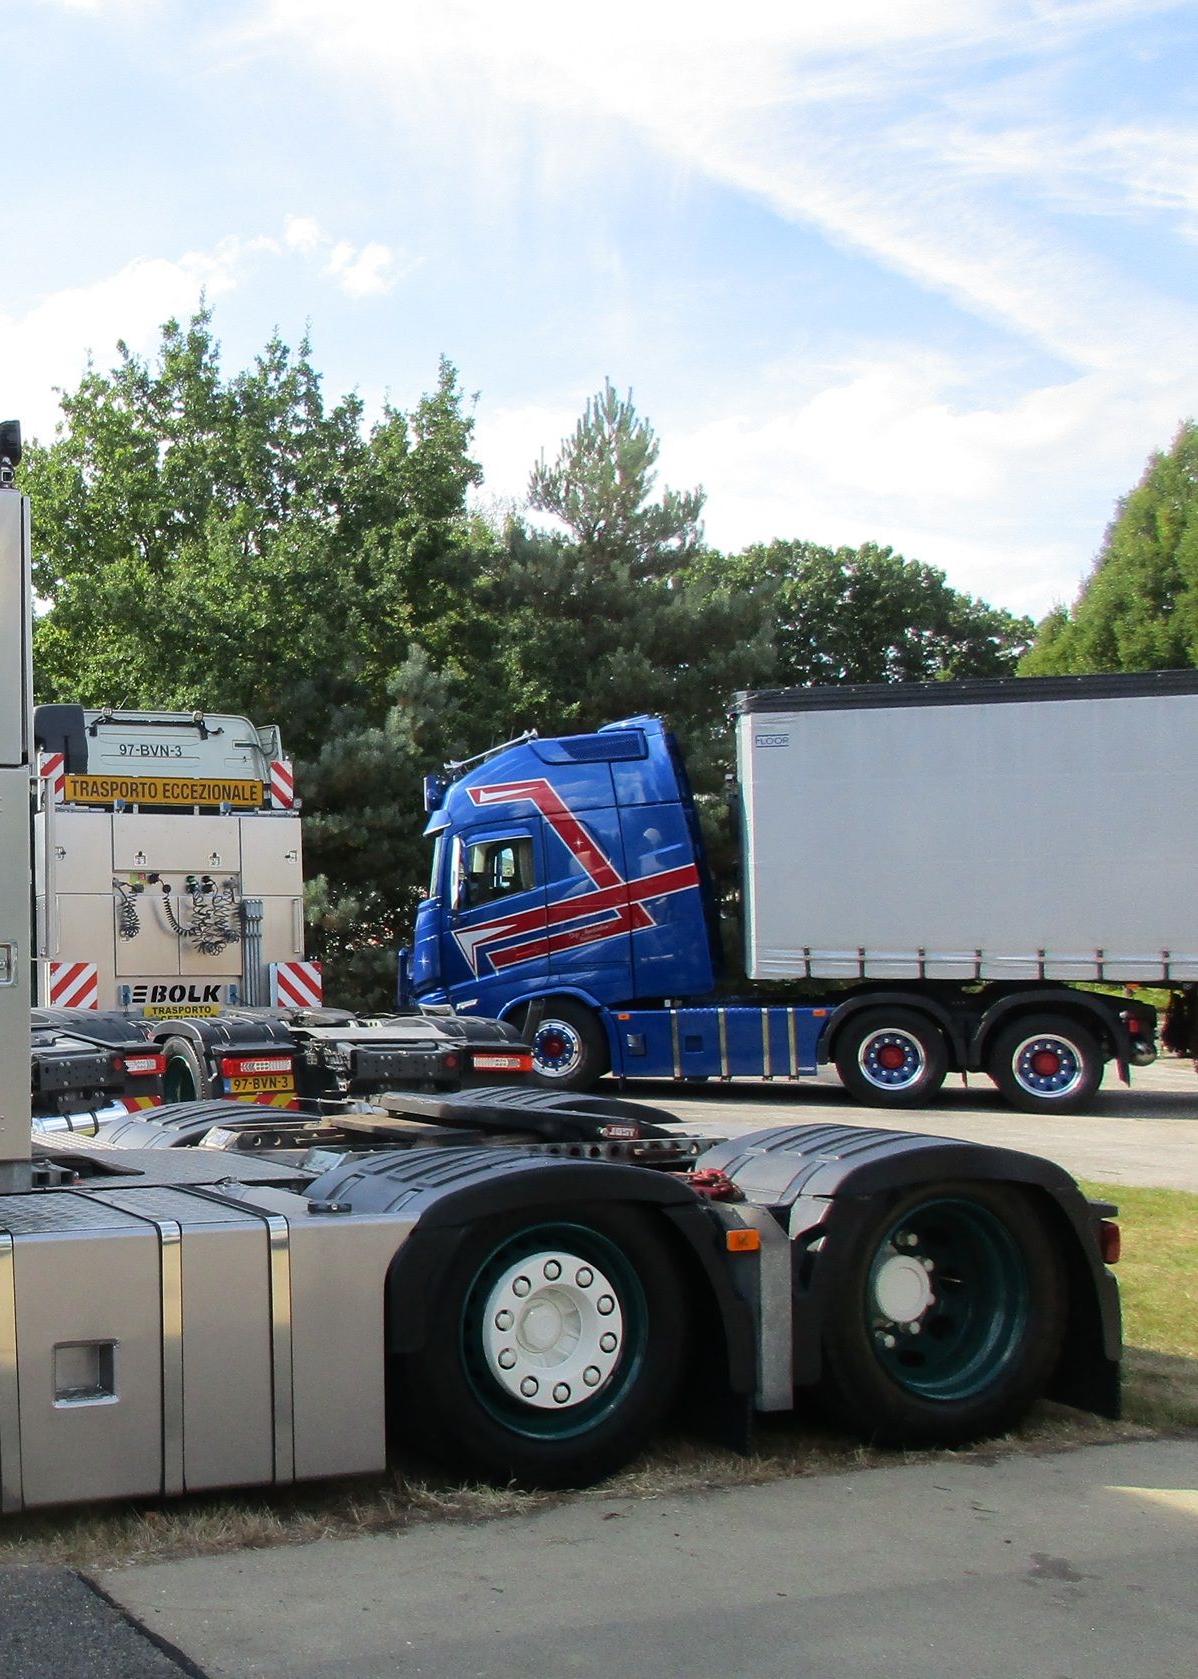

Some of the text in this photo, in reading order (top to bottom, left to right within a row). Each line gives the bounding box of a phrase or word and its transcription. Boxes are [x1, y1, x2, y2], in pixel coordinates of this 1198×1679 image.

[755, 735, 789, 745] FLOOR
[119, 744, 182, 757] 97-BVN-3
[71, 780, 257, 801] TRASPORTO ECCEZIONALE
[151, 985, 221, 1003] BOLK
[152, 1006, 211, 1014] TRASPORTO
[234, 1077, 288, 1090] 97-BVN-3
